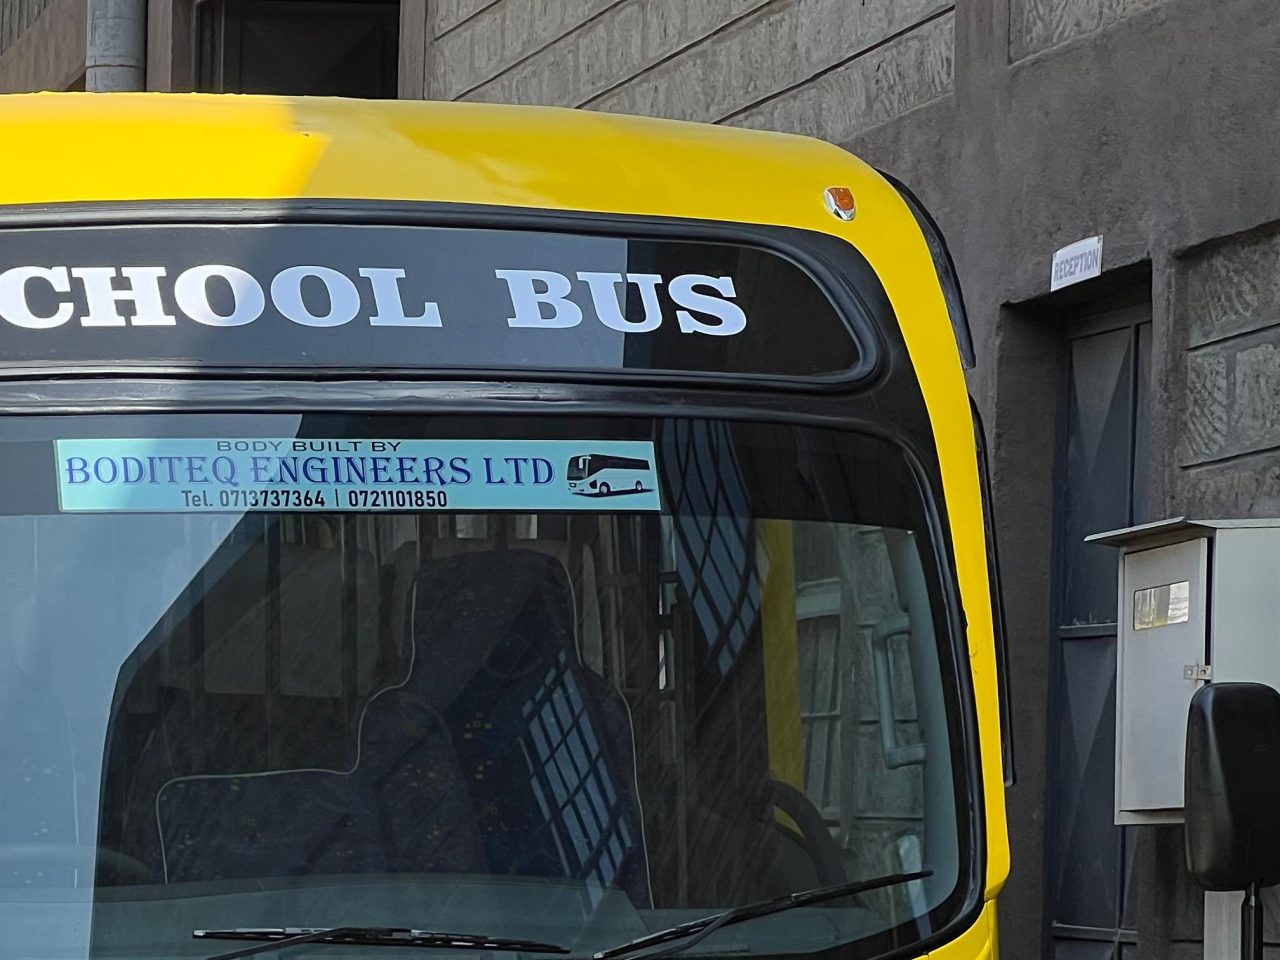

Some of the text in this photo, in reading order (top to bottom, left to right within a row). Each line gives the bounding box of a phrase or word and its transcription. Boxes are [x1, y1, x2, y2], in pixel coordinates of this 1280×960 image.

[1054, 248, 1099, 280] RECEPTION
[495, 268, 748, 338] BUS
[216, 440, 402, 453] BODY BUILT BY
[64, 456, 556, 488] BODITEQ ENGINEERS LTD
[181, 489, 215, 508] Tel.
[218, 489, 326, 509] 0713737364
[347, 489, 448, 509] 0721101850
